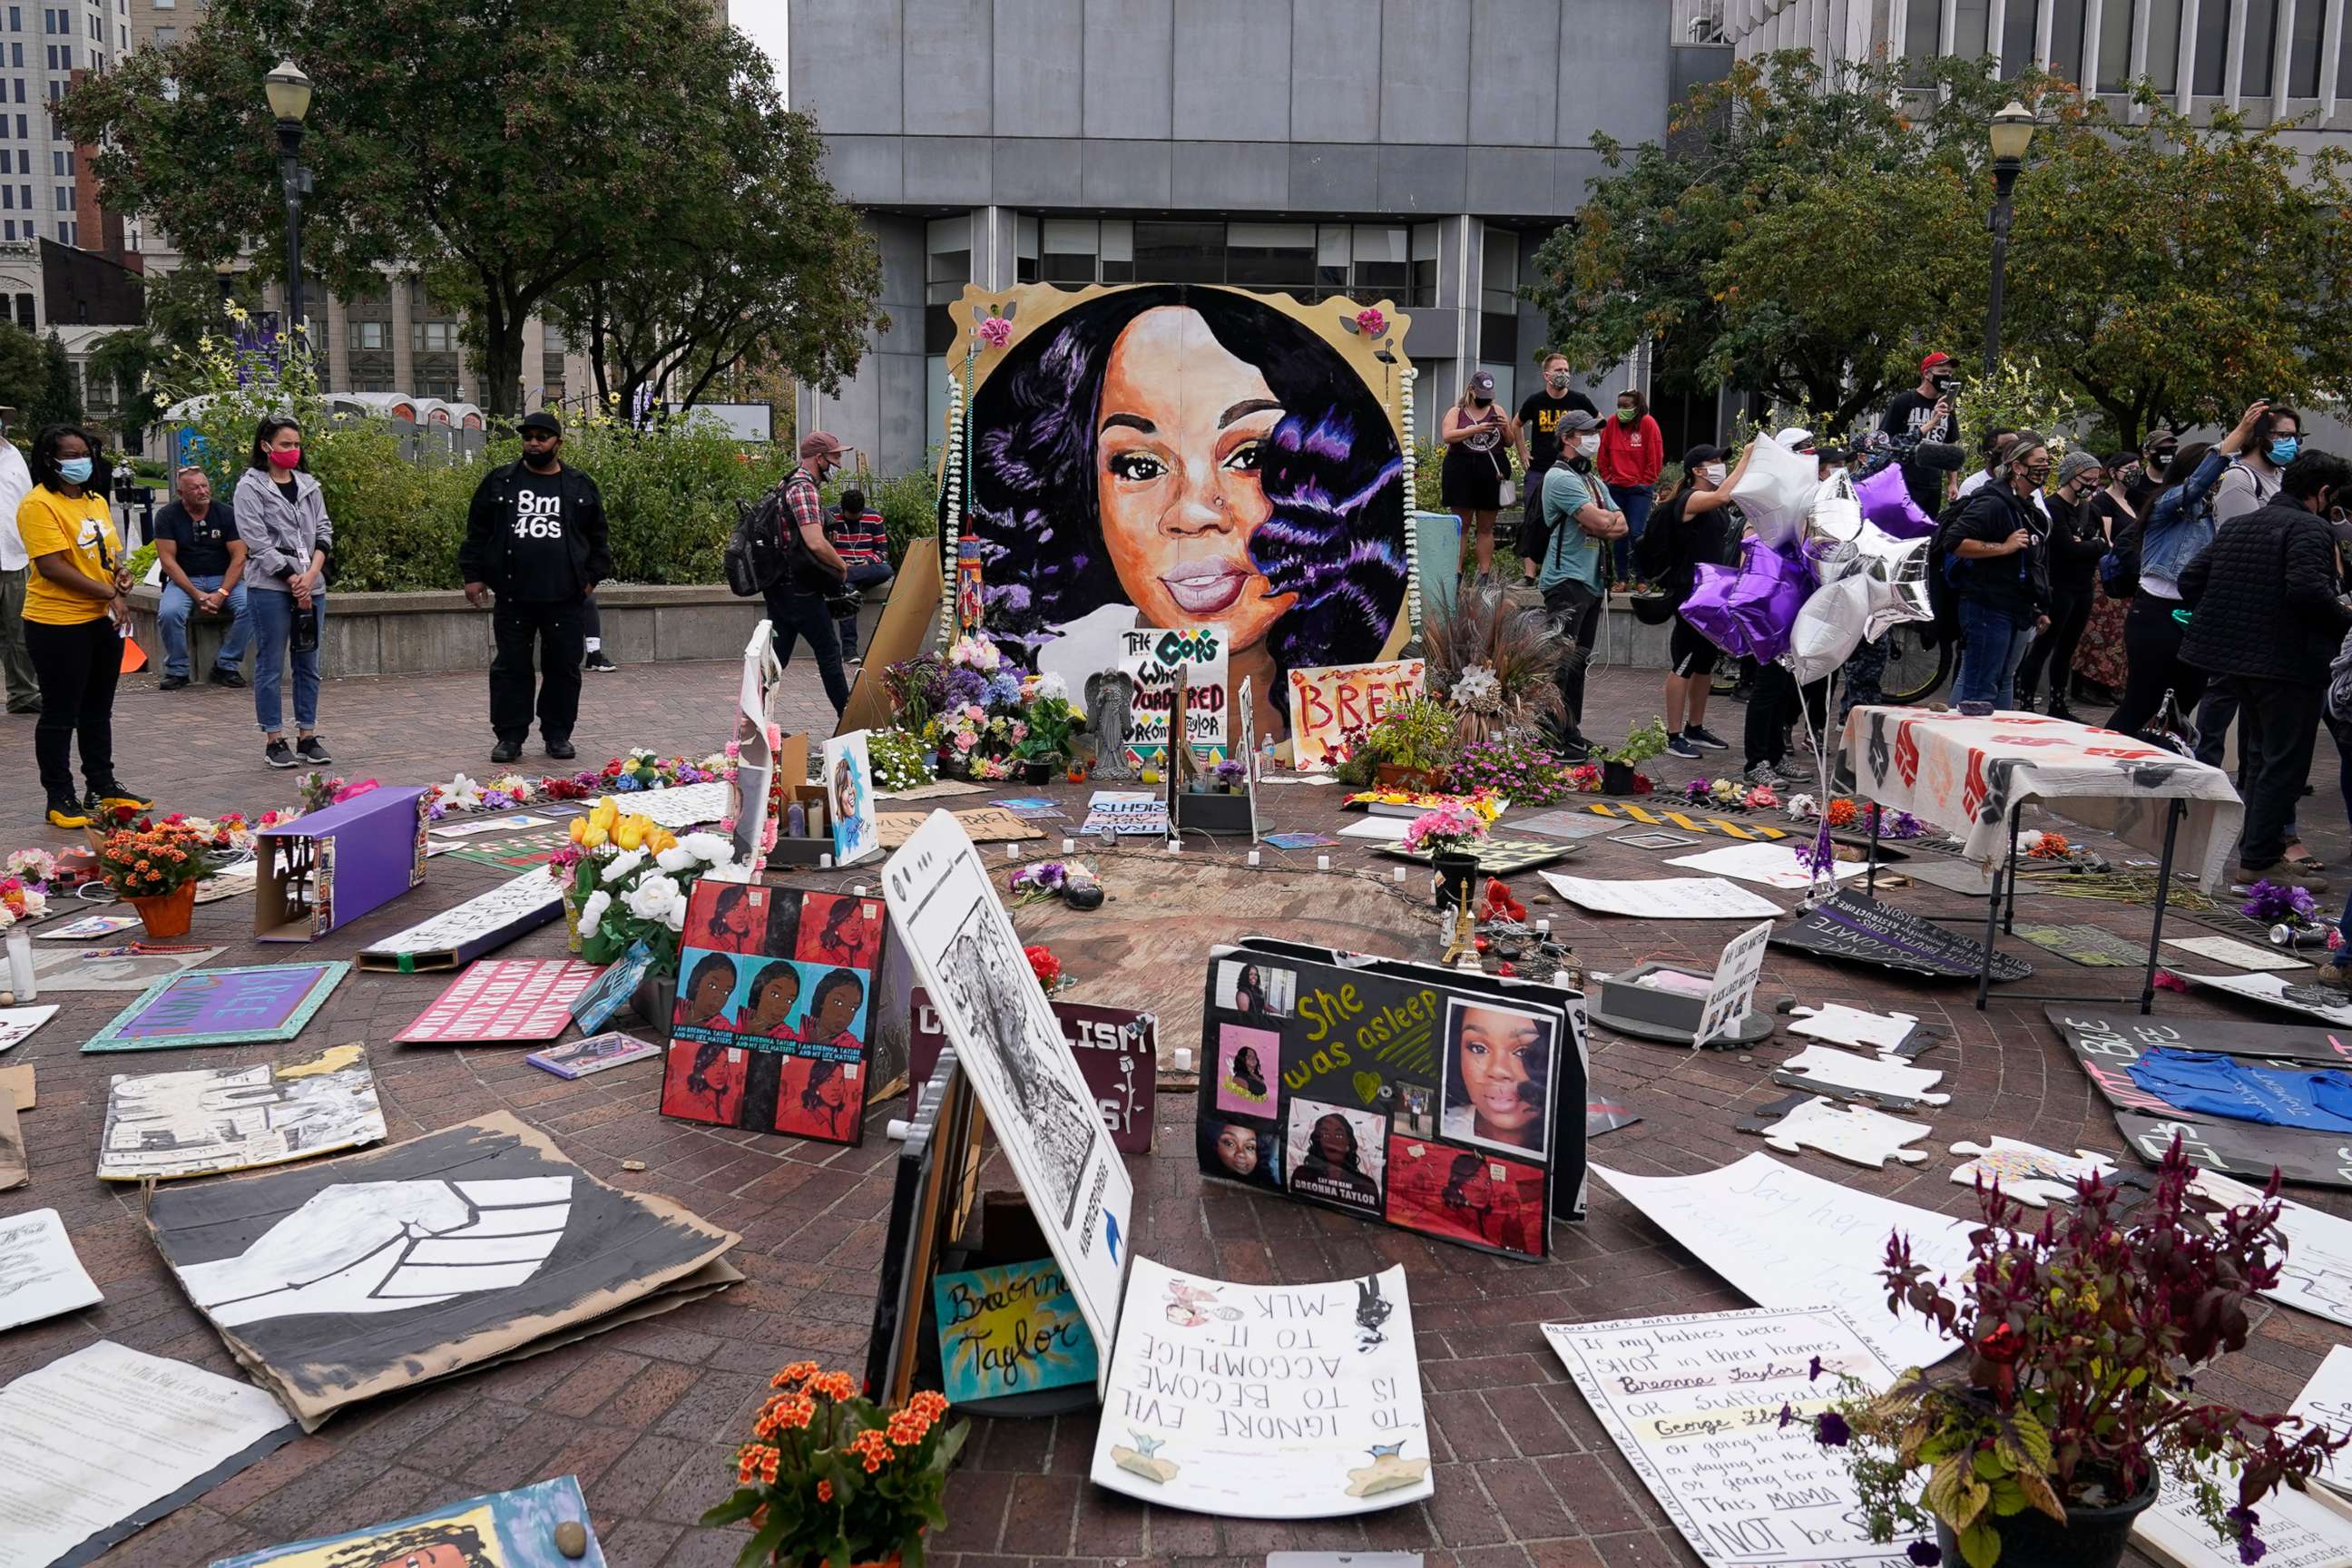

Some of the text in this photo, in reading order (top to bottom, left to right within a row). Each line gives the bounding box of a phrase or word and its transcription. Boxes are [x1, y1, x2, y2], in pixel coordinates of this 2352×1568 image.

[517, 489, 560, 514] 8m
[514, 516, 562, 538] 46s
[1122, 632, 1152, 656] THE
[1092, 803, 1167, 813] RIGHTS
[491, 960, 542, 979] SAY
[468, 981, 524, 1005] HER
[1298, 983, 1365, 1041] She
[687, 1027, 711, 1036] BREONNA
[712, 1030, 733, 1038] TAYLOR
[696, 1034, 707, 1043] LIFE
[707, 1036, 732, 1044] MATTERS
[1283, 989, 1437, 1089] was asleep
[759, 1043, 770, 1052] LIFE
[770, 1045, 796, 1054] MATTERS
[821, 1053, 834, 1061] LIFE
[834, 1054, 860, 1063] MATTERS
[1295, 1180, 1376, 1206] BREONNA TAYLOR
[1642, 1315, 1699, 1325] MATTER
[1278, 1328, 1320, 1349] TO
[1619, 1336, 1654, 1354] my
[1653, 1329, 1724, 1345] babies
[1737, 1324, 1786, 1338] were
[957, 1318, 1079, 1387] Taylor
[1139, 1333, 1341, 1378] ACCOMPLICE
[1596, 1340, 1840, 1374] SHOT in their homes
[1728, 1362, 1803, 1382] Taylor
[1137, 1365, 1396, 1409] IS TO BECOME
[1118, 1387, 1184, 1429] EVIL
[1626, 1401, 1671, 1418] OR
[1218, 1409, 1337, 1439] IGNORE
[1654, 1410, 1731, 1436] George
[1666, 1443, 1690, 1456] or
[1704, 1436, 1757, 1458] going
[1690, 1458, 1749, 1477] playing
[1756, 1455, 1775, 1467] in
[1781, 1451, 1814, 1462] the
[1723, 1473, 1782, 1493] going
[1784, 1468, 1817, 1483] for
[1826, 1468, 1842, 1477] a
[1692, 1495, 1756, 1514] This
[1769, 1485, 1840, 1510] MAMA
[1707, 1517, 1785, 1553] NOT
